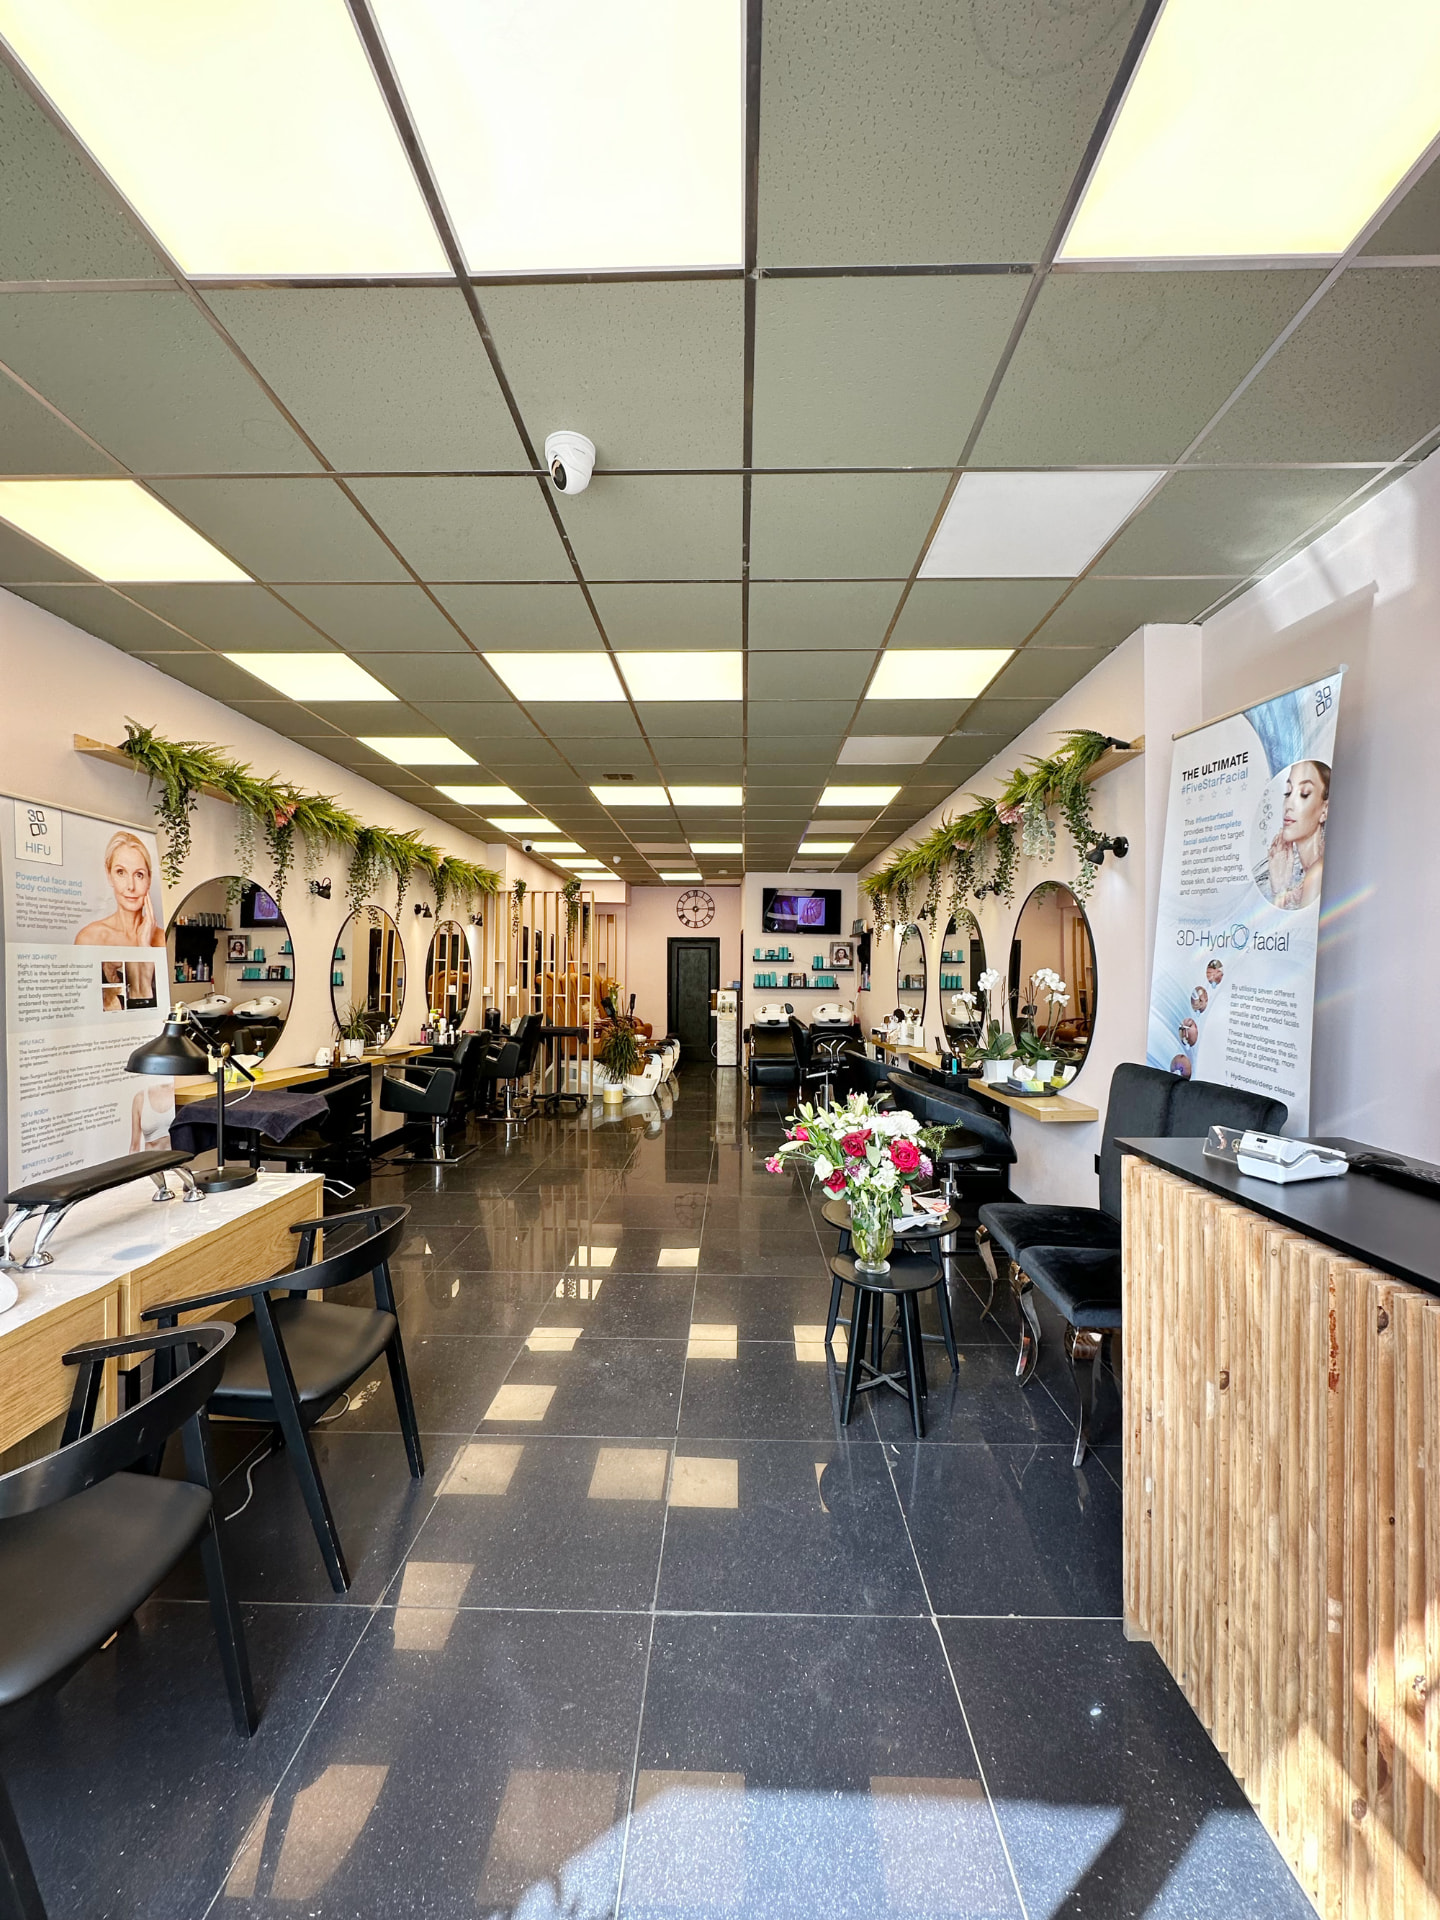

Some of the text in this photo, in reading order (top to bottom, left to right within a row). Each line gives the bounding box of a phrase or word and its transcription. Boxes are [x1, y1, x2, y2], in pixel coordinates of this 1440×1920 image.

[1182, 751, 1248, 781] THE ULTIMATE
[1181, 767, 1248, 795] #FiveStarFacial
[1184, 827, 1204, 837] provides
[1214, 820, 1242, 830] complete
[1183, 838, 1197, 846] facial
[1198, 835, 1219, 844] solution
[1228, 830, 1245, 840] target
[25, 841, 51, 856] HIFU
[1190, 848, 1201, 856] array
[1209, 843, 1232, 853] universal
[1193, 856, 1214, 865] concerns
[1215, 853, 1240, 862] including
[16, 872, 50, 883] Powerful
[51, 876, 67, 886] face
[1206, 876, 1215, 884] dull
[16, 882, 82, 896] body combination
[1253, 931, 1290, 952] facial
[1231, 993, 1254, 1002] advanced
[1232, 984, 1295, 998] By utilising seven different
[1240, 1002, 1251, 1010] offer
[1230, 1010, 1249, 1018] versatile
[1261, 1015, 1282, 1024] rounded
[1284, 1020, 1300, 1028] facials
[1228, 1028, 1242, 1038] These
[1243, 1032, 1275, 1044] technologies
[1227, 1038, 1245, 1047] hydrate
[1257, 1045, 1277, 1054] cleanse
[1225, 1055, 1245, 1064] youthful
[1226, 1046, 1247, 1057] resulting
[1281, 1060, 1295, 1069] more
[1274, 1086, 1296, 1097] cleanse
